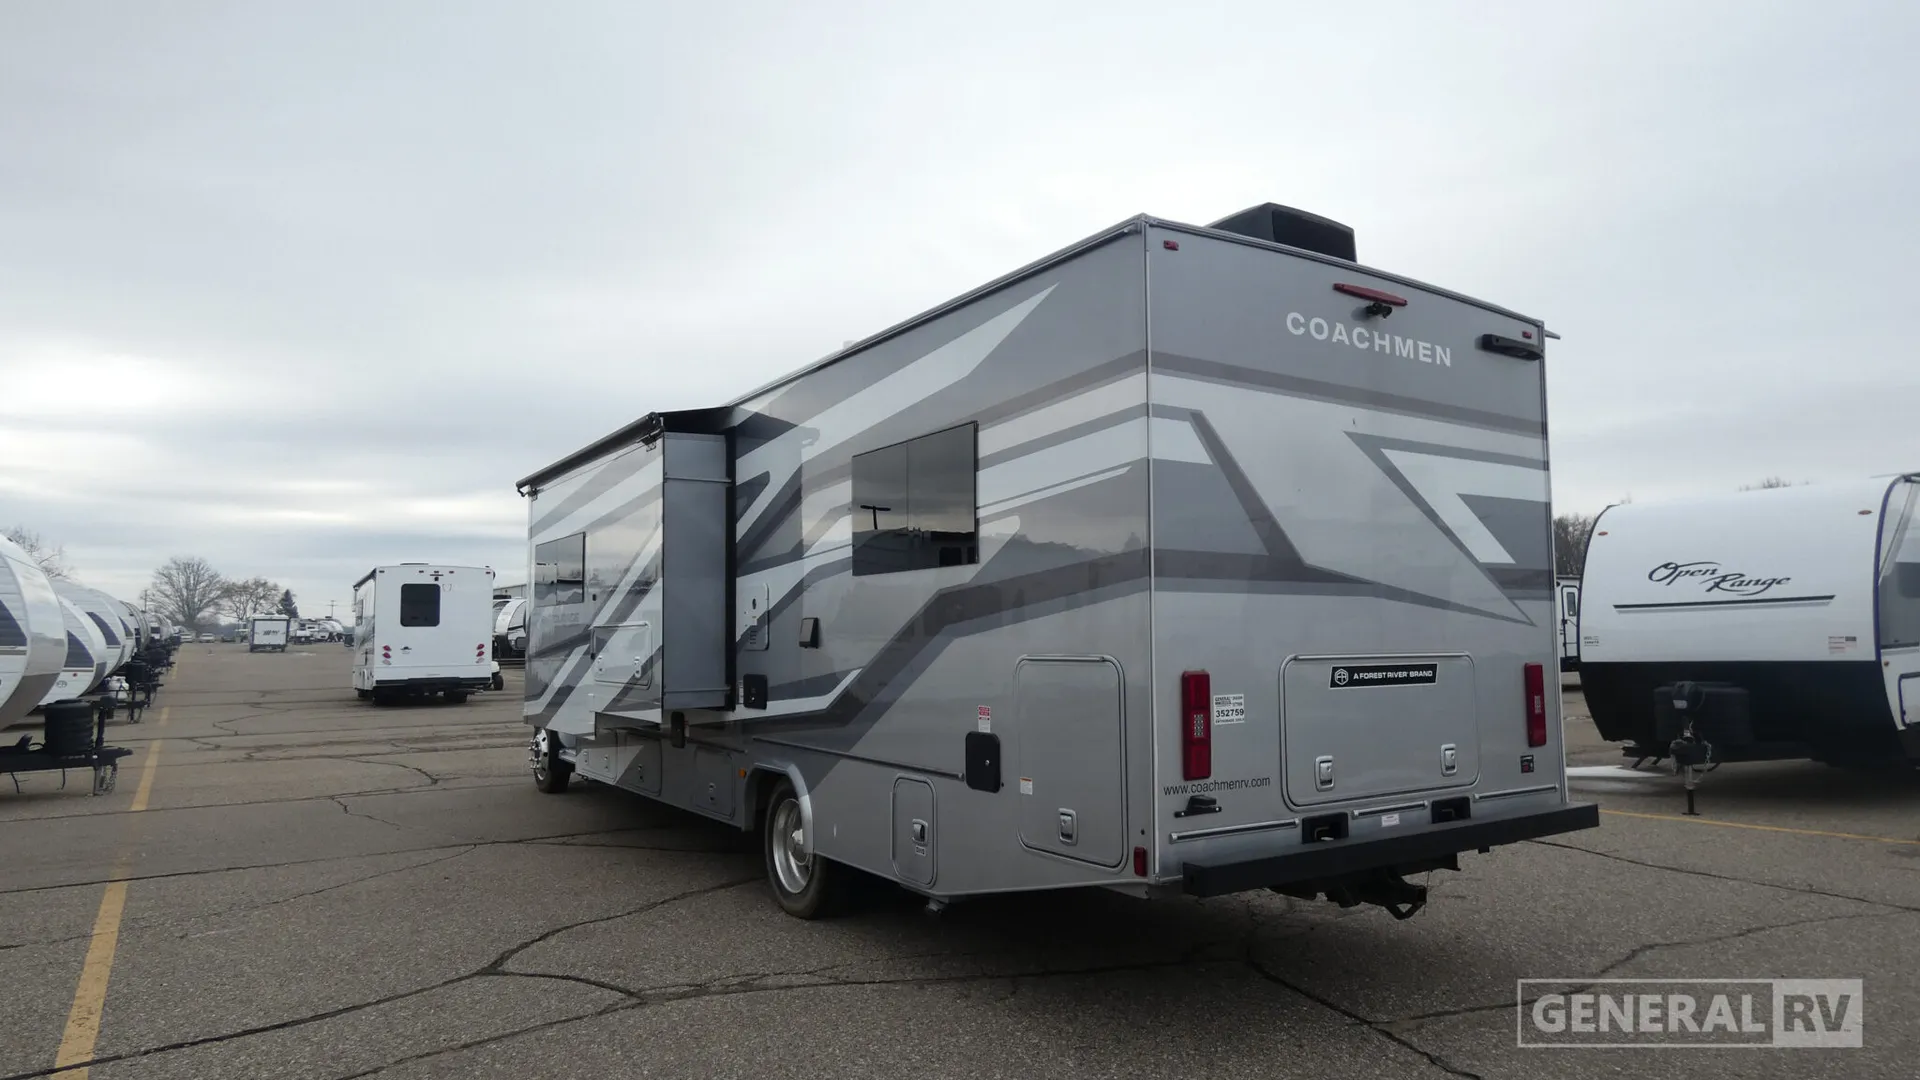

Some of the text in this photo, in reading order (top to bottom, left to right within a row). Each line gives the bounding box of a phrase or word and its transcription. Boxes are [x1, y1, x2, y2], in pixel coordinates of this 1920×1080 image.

[1286, 312, 1451, 367] COACHMEN
[1648, 562, 1791, 596] Open Range
[1353, 670, 1433, 680] A FOREST RIVER BRAND
[1215, 708, 1245, 718] 352759
[1163, 777, 1271, 796] www.coachmenrv.com
